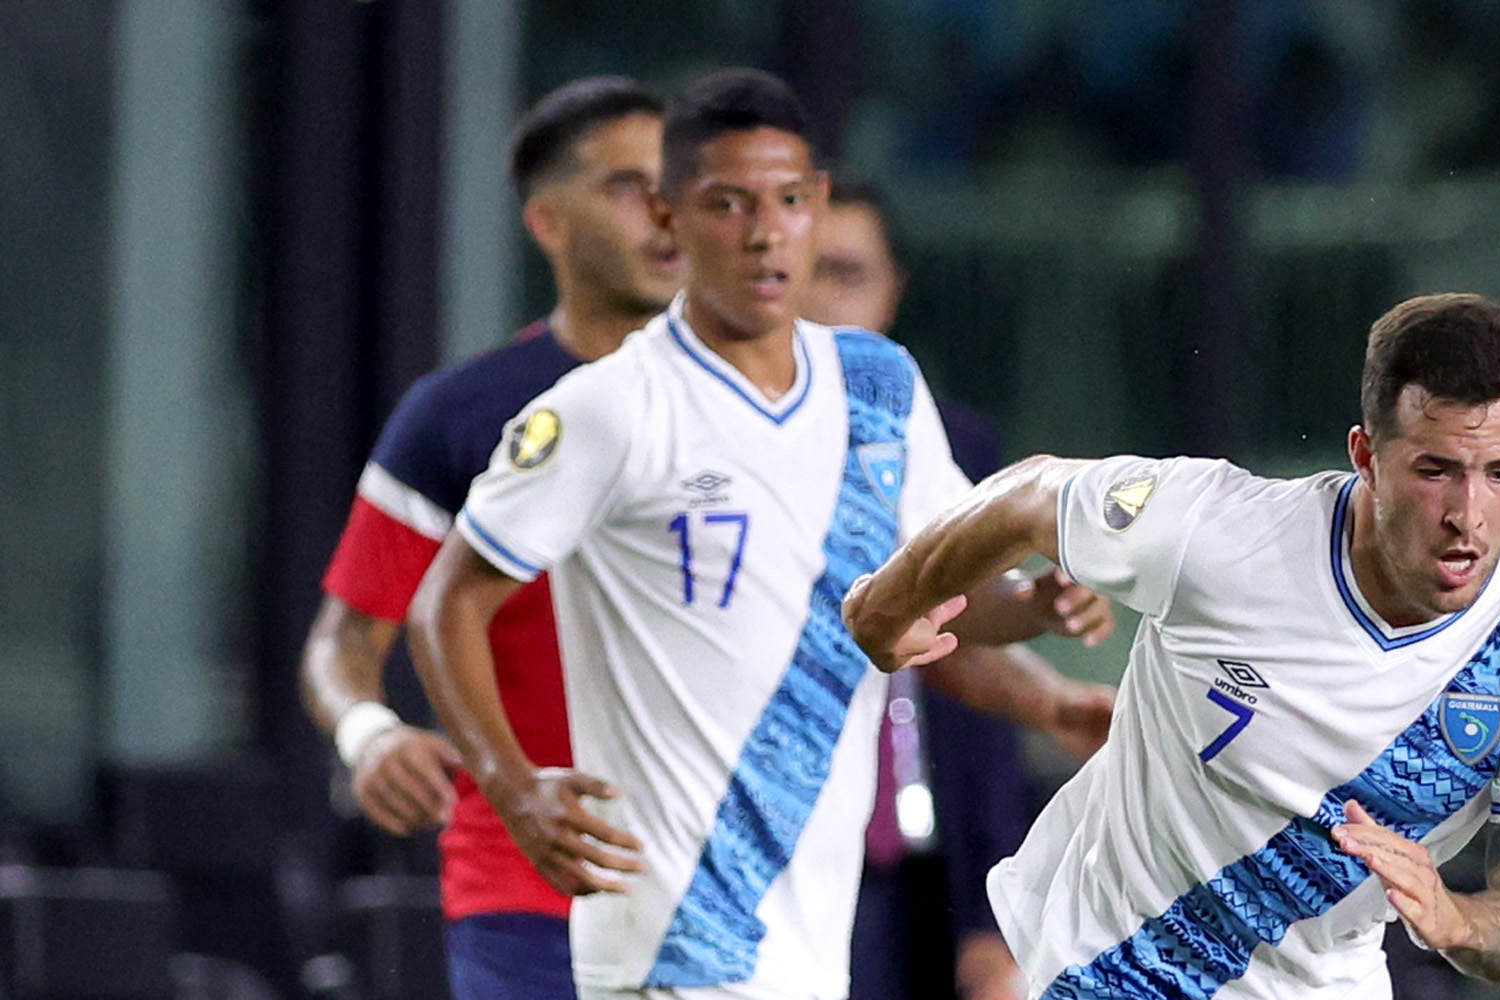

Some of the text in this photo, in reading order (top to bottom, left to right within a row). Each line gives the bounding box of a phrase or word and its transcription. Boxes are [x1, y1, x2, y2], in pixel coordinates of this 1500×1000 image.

[668, 513, 749, 607] 17
[1214, 677, 1258, 705] umbro
[1448, 700, 1500, 712] GUATEMALA
[1197, 686, 1255, 763] 7
